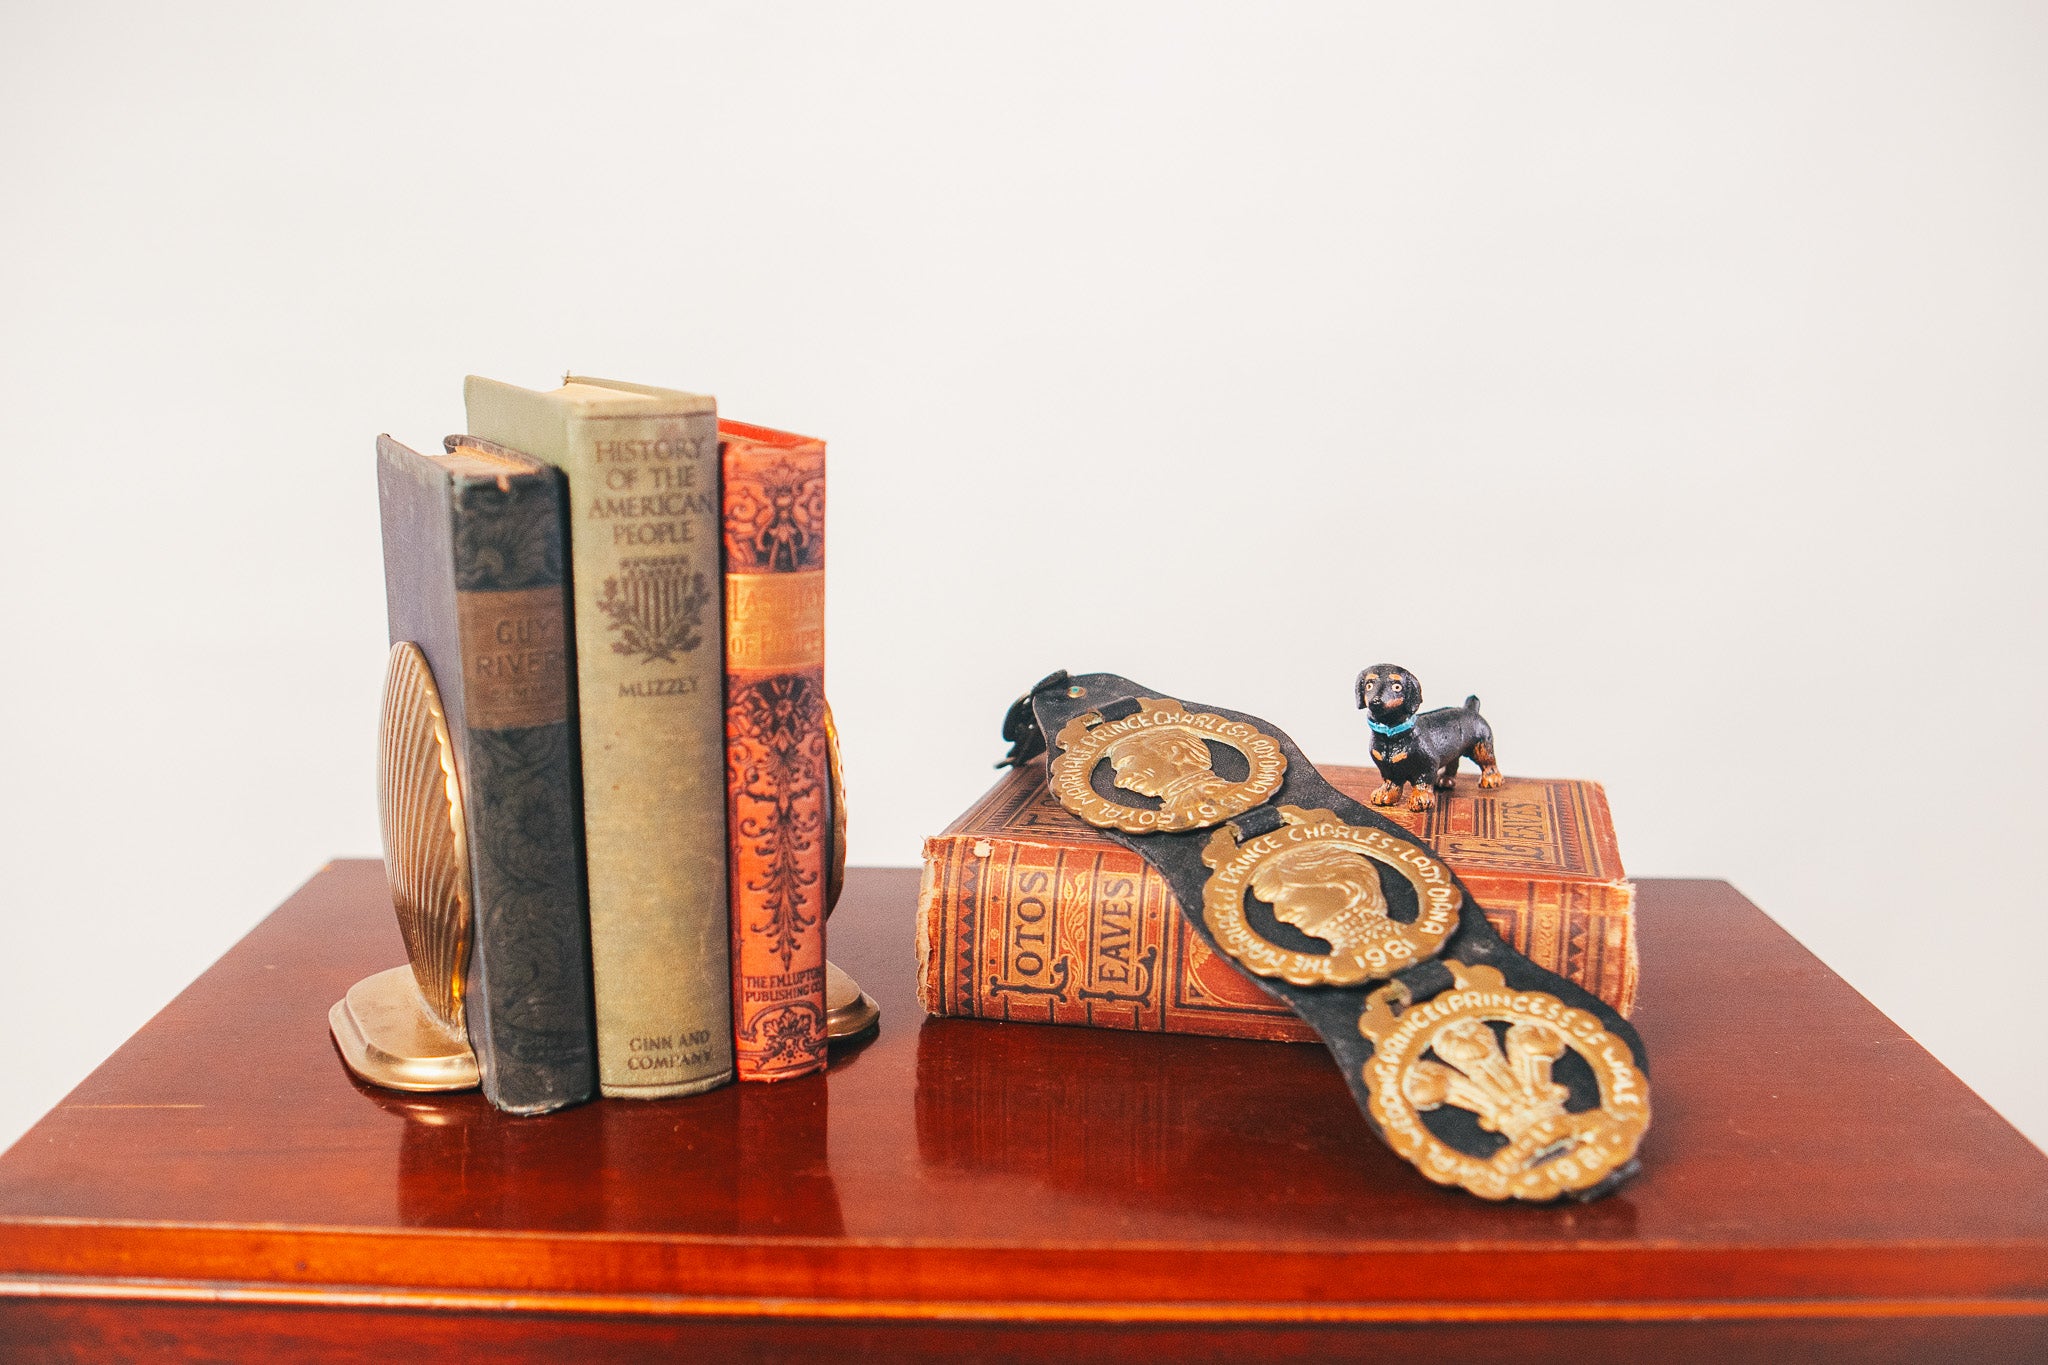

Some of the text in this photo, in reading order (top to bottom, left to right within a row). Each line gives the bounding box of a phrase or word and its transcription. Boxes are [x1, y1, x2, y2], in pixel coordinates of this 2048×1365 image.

[594, 436, 706, 463] HISTORY
[606, 464, 696, 491] OF THE
[588, 491, 717, 520] AMERICAN
[613, 518, 698, 546] PEOPLE
[617, 678, 698, 698] MUZZEY
[1081, 714, 1153, 750] PRINCE
[1153, 711, 1244, 736] CHARLES
[1241, 733, 1278, 760] LADY
[1058, 743, 1097, 806] MARRIAGE
[1243, 760, 1281, 795] DIANA
[1098, 801, 1176, 825] ROYAL
[1287, 823, 1389, 850] CHARLES
[1218, 836, 1283, 884] PRINCE
[1399, 848, 1444, 888] LADY
[1418, 886, 1454, 936] DIANA
[989, 868, 1070, 1003] LOTOS
[1078, 877, 1157, 1008] LEAVES
[1212, 903, 1288, 968] MARRIAGE
[1288, 954, 1334, 976] THE
[1353, 937, 1419, 970] 1981
[742, 975, 768, 989] THE
[744, 983, 810, 1003] PUBLISHING
[1447, 991, 1576, 1029] PRINCESS
[628, 1030, 711, 1052] GINN AND
[627, 1049, 713, 1072] COMPANY
